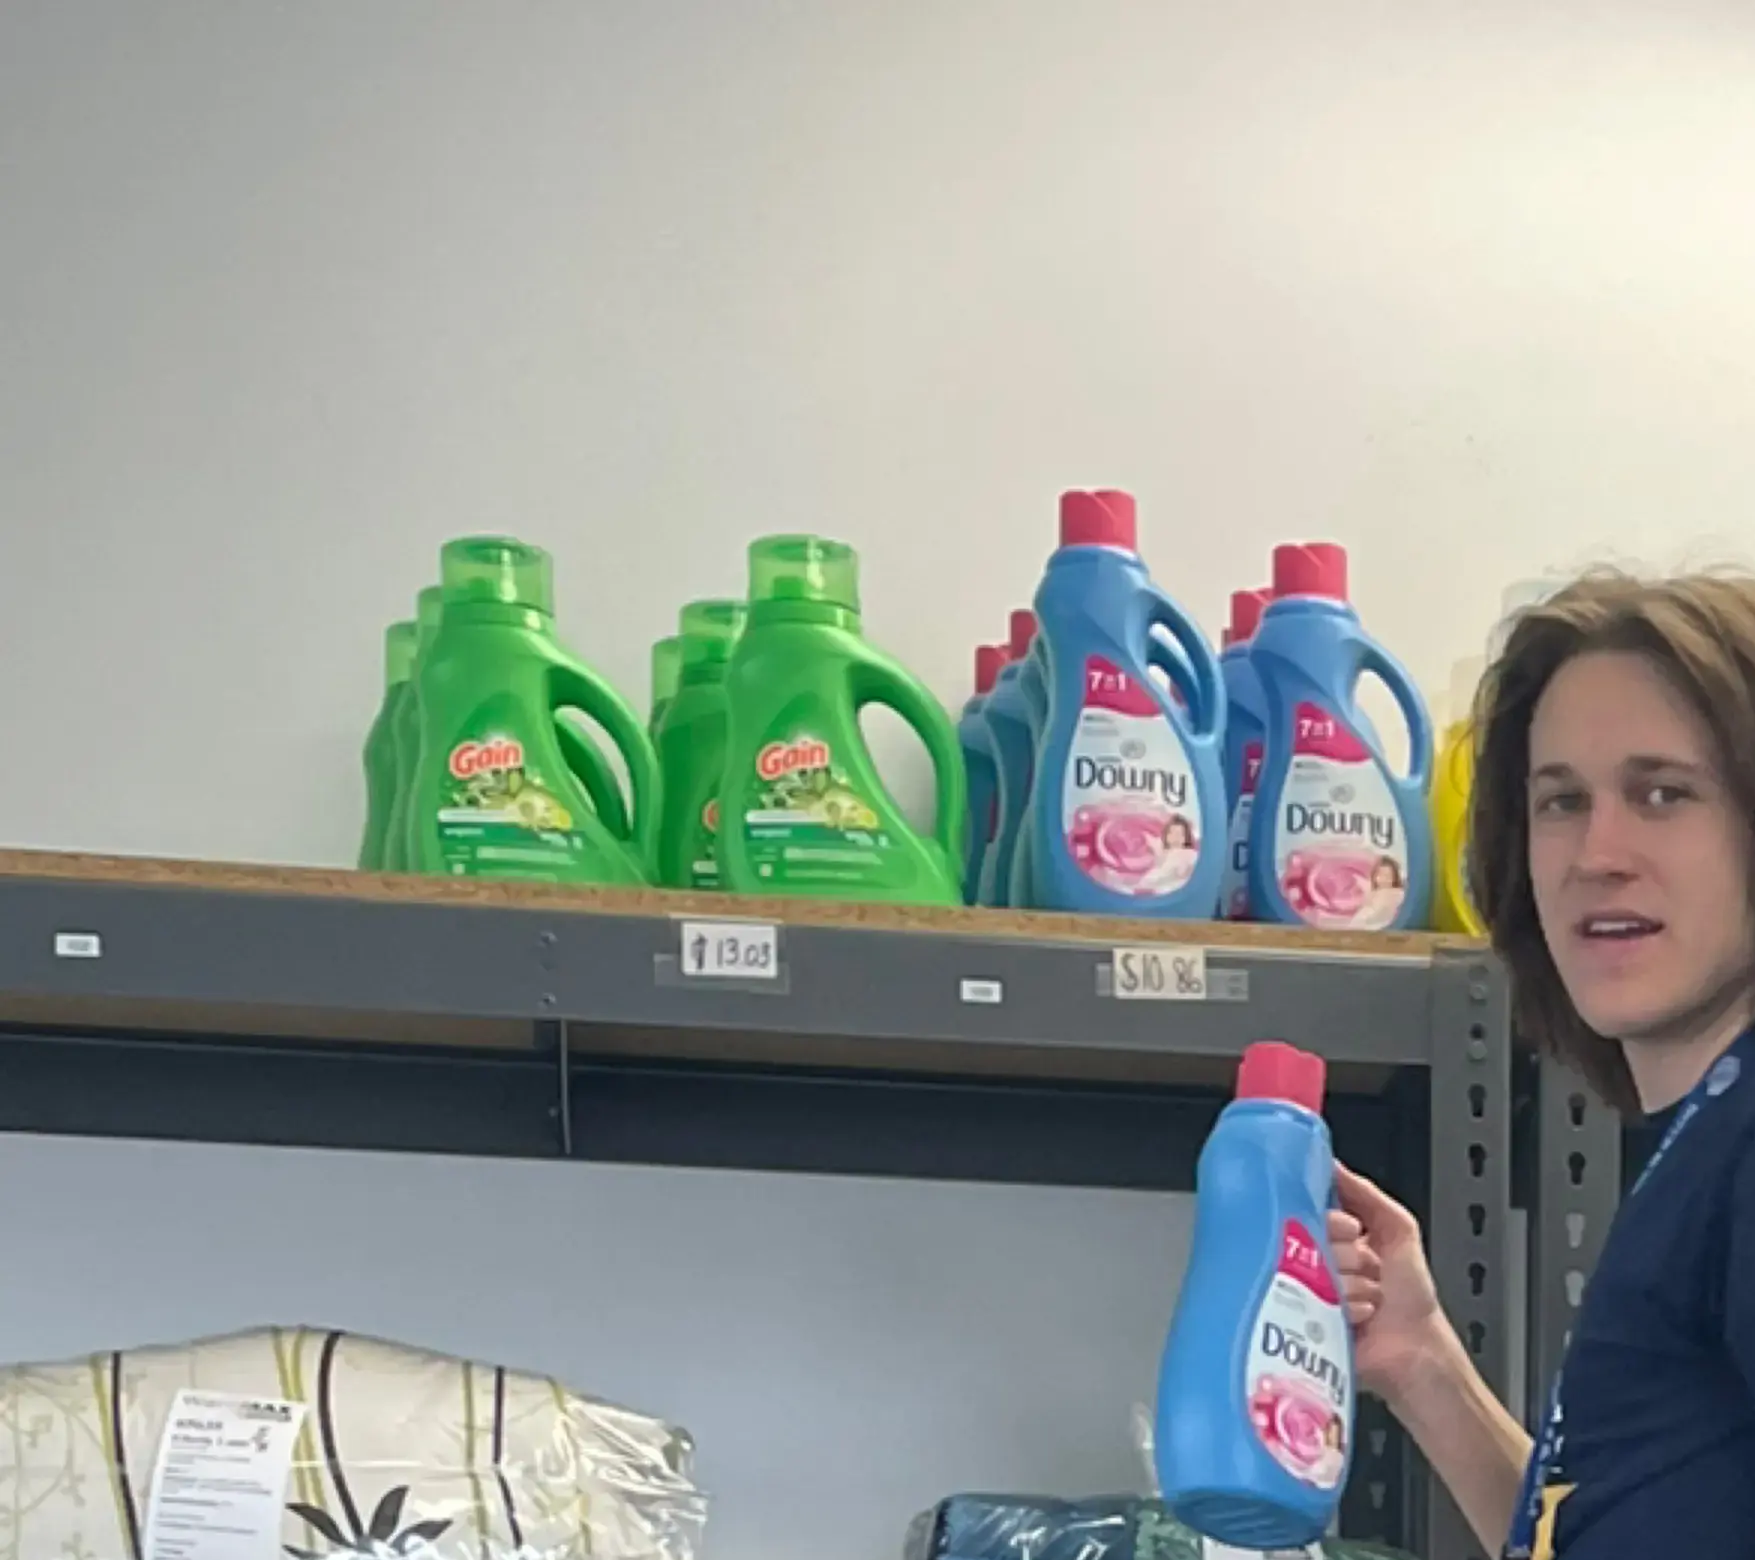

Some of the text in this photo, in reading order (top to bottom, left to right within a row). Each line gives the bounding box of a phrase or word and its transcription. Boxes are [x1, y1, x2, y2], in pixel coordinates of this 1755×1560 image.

[452, 742, 522, 777] Gain
[758, 742, 829, 778] Gain
[1076, 756, 1186, 808] Downy
[1286, 803, 1394, 849] Downy
[1262, 1321, 1346, 1408] Downy
